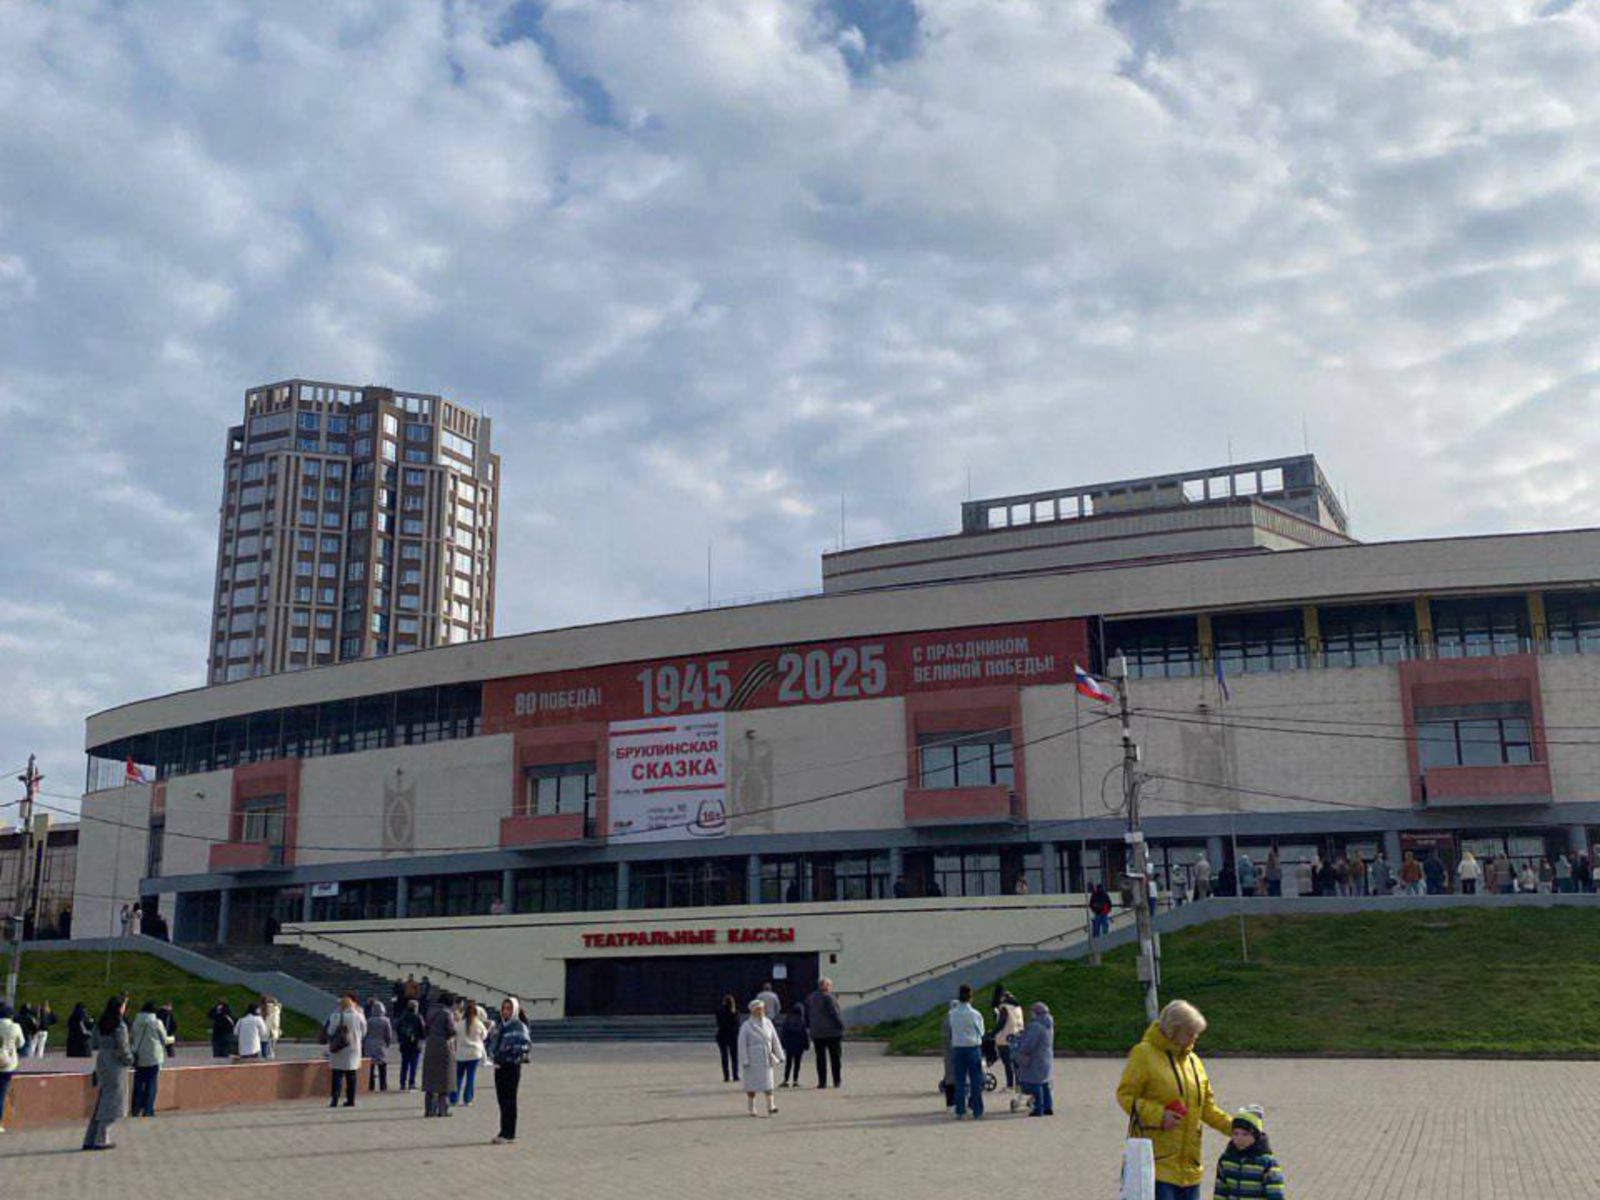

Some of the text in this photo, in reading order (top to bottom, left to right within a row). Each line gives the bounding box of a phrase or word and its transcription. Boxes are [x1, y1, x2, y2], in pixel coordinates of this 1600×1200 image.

[912, 637, 1029, 663] С ПРАЗДНИКОМ
[778, 644, 887, 702] 2025
[914, 655, 1055, 683] ВЕЛИКОЙ ПОБЕДЫ!
[539, 687, 602, 711] ПОБЕДА!
[637, 660, 732, 714] 1945
[631, 758, 718, 781] СКАЗКА
[581, 927, 795, 948] ТЕАТРАЛЬНЫЕ КАССЫ
